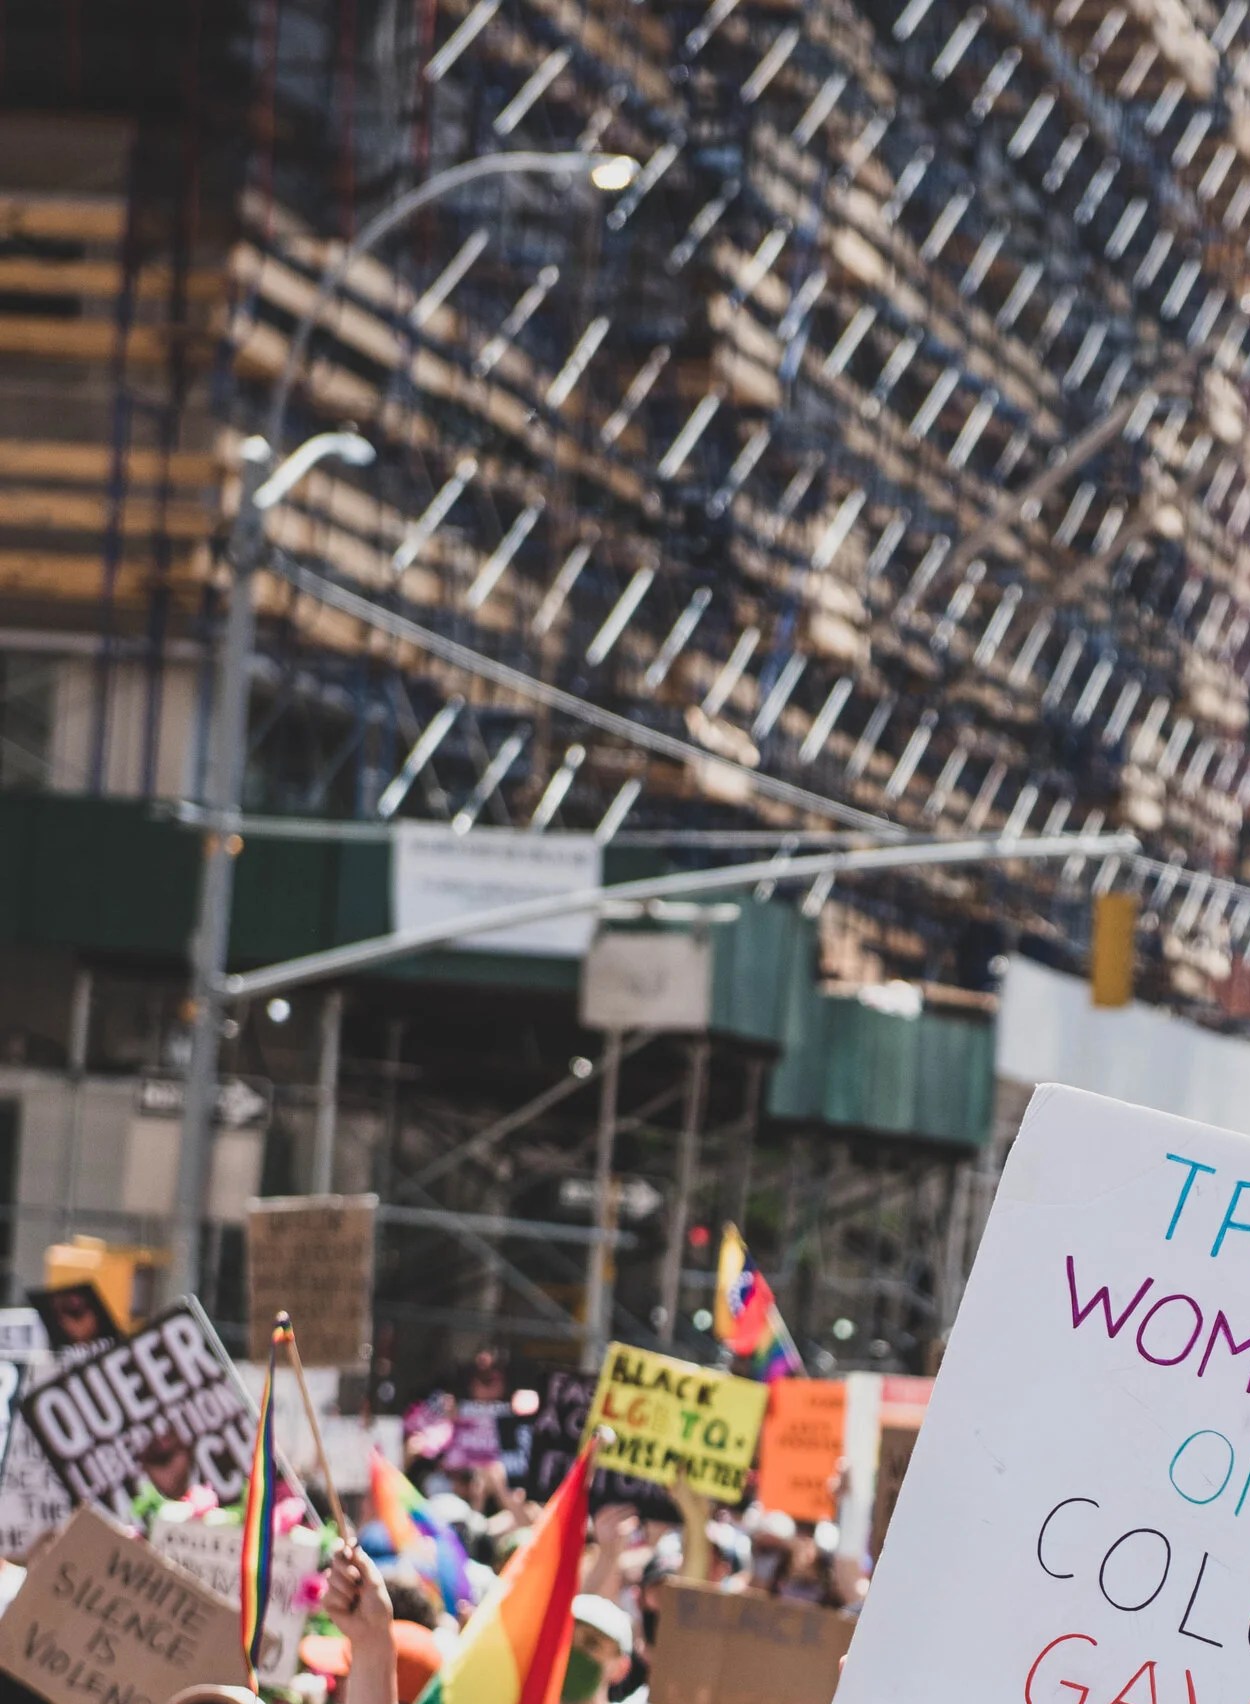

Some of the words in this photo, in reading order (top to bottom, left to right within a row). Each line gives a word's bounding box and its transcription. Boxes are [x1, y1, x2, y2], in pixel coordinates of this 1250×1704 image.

[36, 1312, 226, 1460] QUEER
[612, 1351, 720, 1406] BLACK
[662, 1446, 744, 1490] MATTER
[53, 1560, 196, 1670] SILENCE
[105, 1549, 210, 1630] WHITE
[86, 1624, 117, 1668] IS
